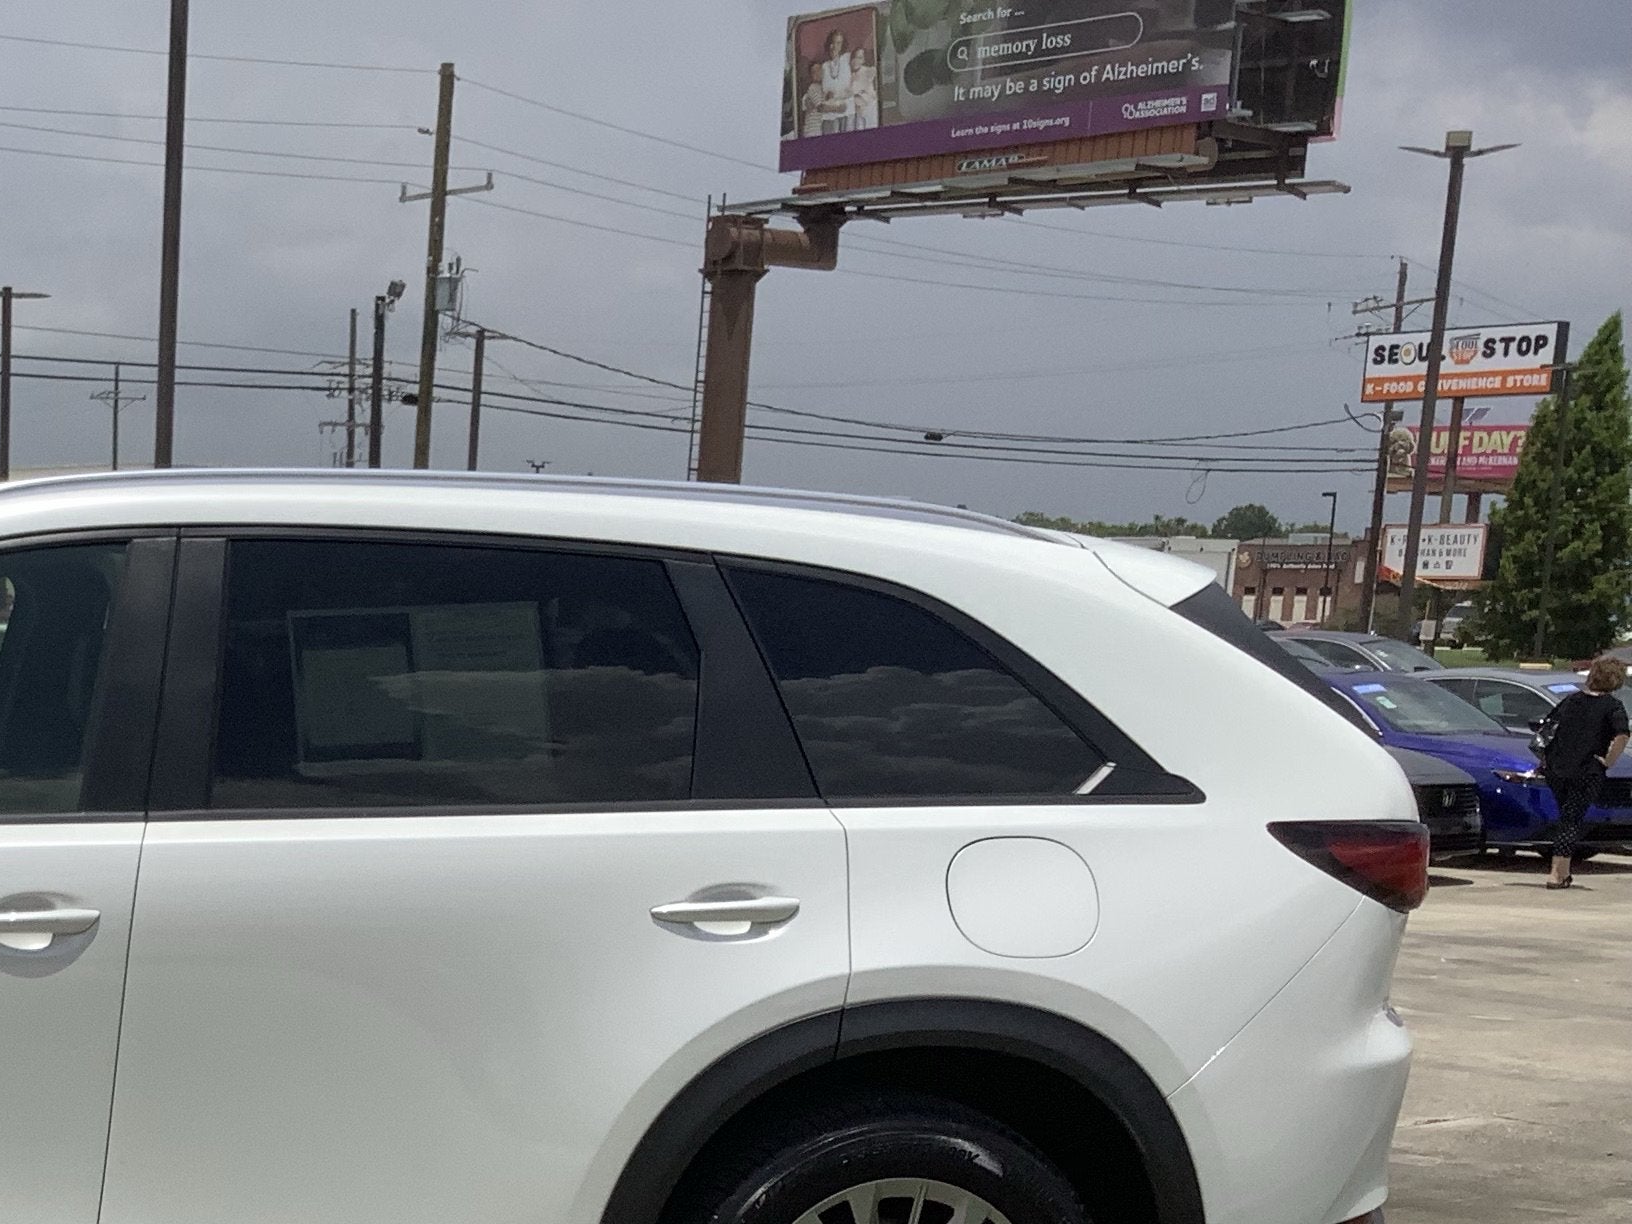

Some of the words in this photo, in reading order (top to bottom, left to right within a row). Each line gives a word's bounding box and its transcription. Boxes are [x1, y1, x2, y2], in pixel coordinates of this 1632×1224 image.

[960, 9, 994, 25] Search
[997, 7, 1012, 18] for
[977, 38, 1037, 59] memory
[1041, 33, 1072, 50] loss
[954, 86, 965, 101] It
[969, 84, 1001, 101] may
[1006, 78, 1024, 95] be
[1029, 80, 1038, 91] a
[1043, 71, 1075, 93] sign
[1080, 66, 1099, 84] of
[1134, 105, 1186, 118] ASSOCIATION
[951, 127, 973, 138] Learn
[975, 125, 988, 134] the
[990, 123, 1010, 135] signs
[1481, 334, 1549, 359] STOP
[1365, 381, 1413, 395] K-FOOD
[1506, 373, 1549, 387] STORE
